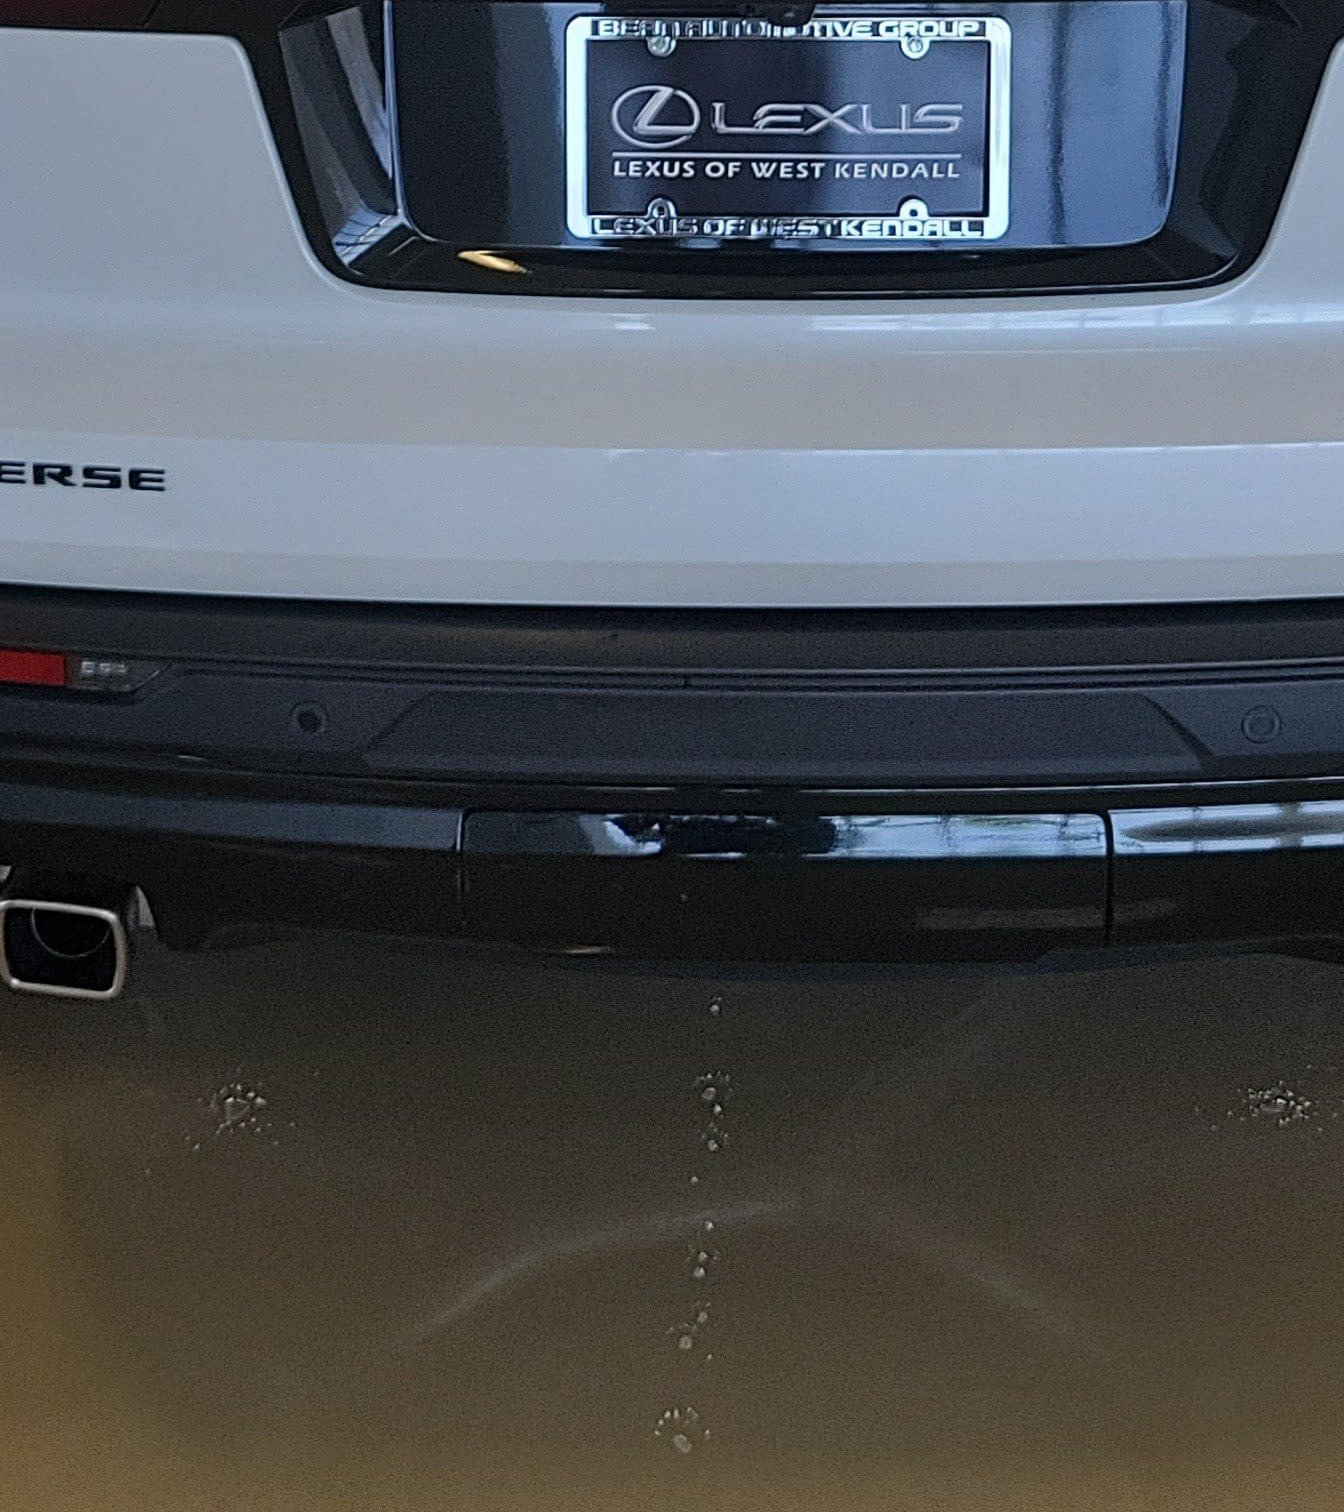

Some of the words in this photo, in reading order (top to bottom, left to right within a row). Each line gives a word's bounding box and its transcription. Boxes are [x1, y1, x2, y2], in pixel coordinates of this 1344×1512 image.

[879, 21, 980, 37] GROUP
[711, 102, 963, 135] LEXUS
[613, 160, 695, 178] LEXUS
[705, 161, 741, 178] OF
[751, 161, 825, 178] WEST
[835, 162, 960, 179] KENDALL
[593, 218, 698, 235] LEXUS
[703, 219, 745, 235] OF
[750, 218, 838, 237] WEST
[841, 219, 982, 236] KENDALL
